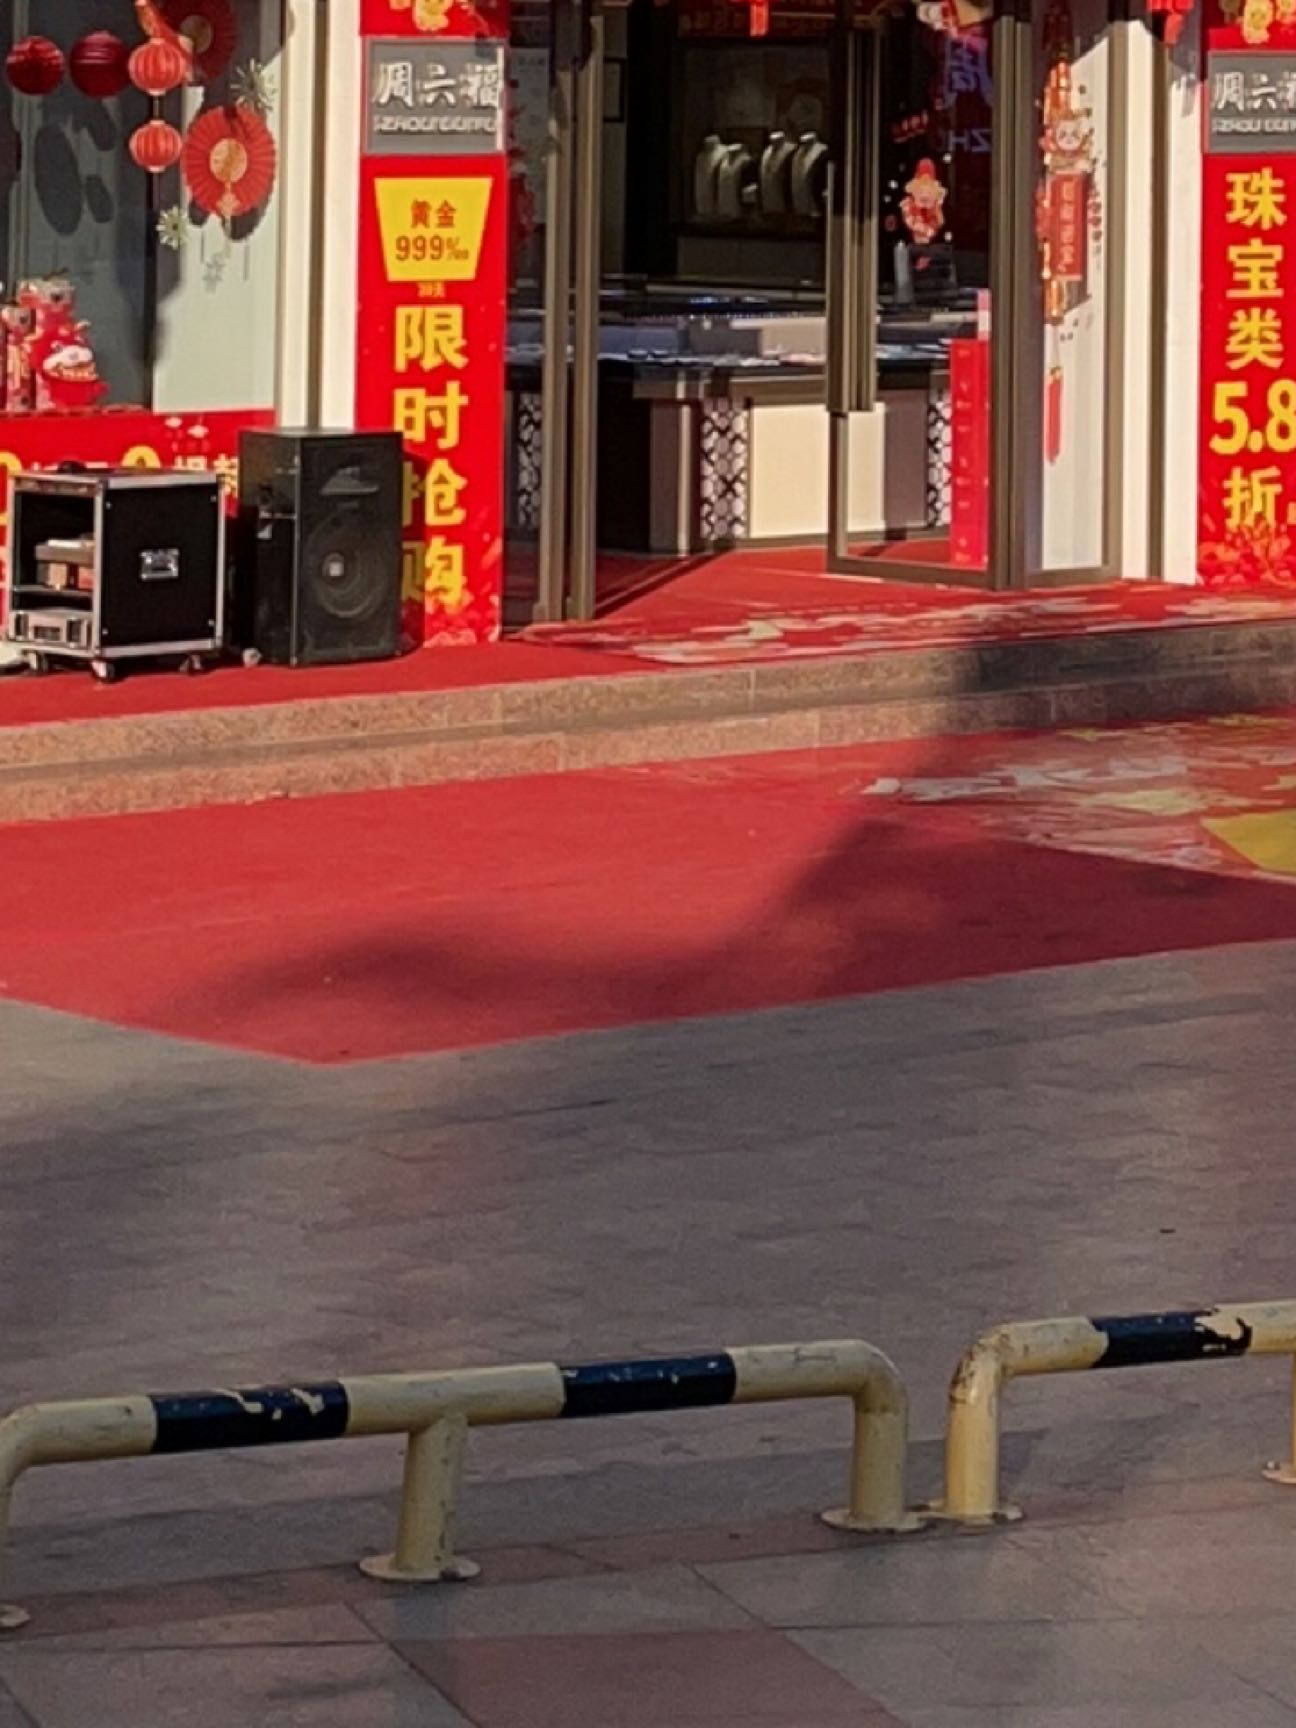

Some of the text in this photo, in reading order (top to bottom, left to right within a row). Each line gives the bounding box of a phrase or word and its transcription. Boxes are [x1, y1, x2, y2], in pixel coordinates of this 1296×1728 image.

[372, 62, 504, 107] 周六福
[391, 303, 470, 606] 限时抢购
